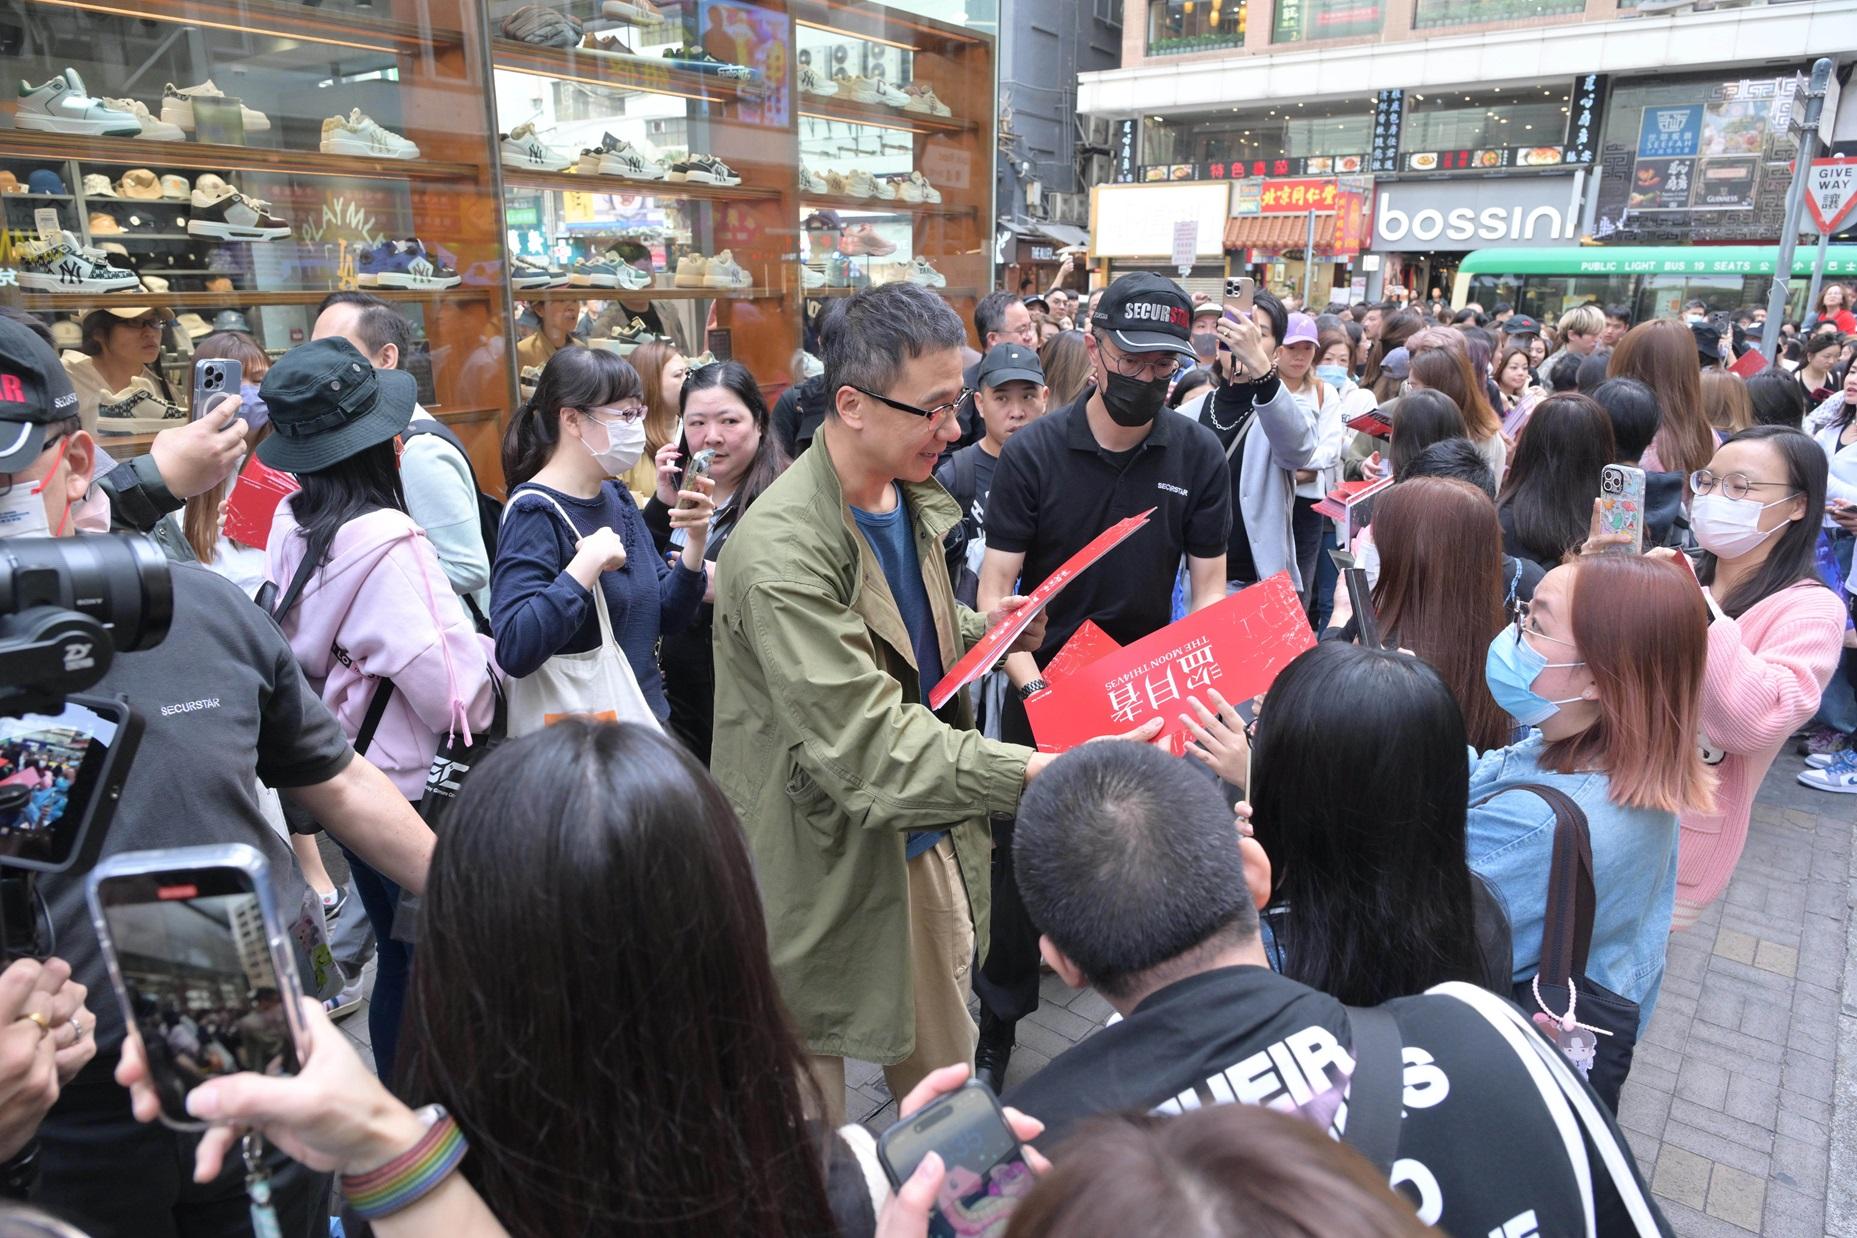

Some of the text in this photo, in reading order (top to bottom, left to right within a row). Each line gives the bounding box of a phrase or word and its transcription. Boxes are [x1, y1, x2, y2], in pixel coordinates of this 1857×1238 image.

[1819, 167, 1853, 179] GIVE
[1819, 179, 1850, 190] WAY
[1262, 184, 1337, 206] 北京同仁堂
[1706, 195, 1738, 203] GUINNESS
[1378, 192, 1576, 241] bossini
[1581, 261, 1751, 271] PUBLIC LIGHT BUS 19 SEATS
[1157, 482, 1189, 497] SECURSTAR
[1184, 635, 1210, 652] THE
[1149, 647, 1183, 669] MOON
[1107, 644, 1223, 723] 盜月者
[160, 698, 221, 717] SECURSTAR
